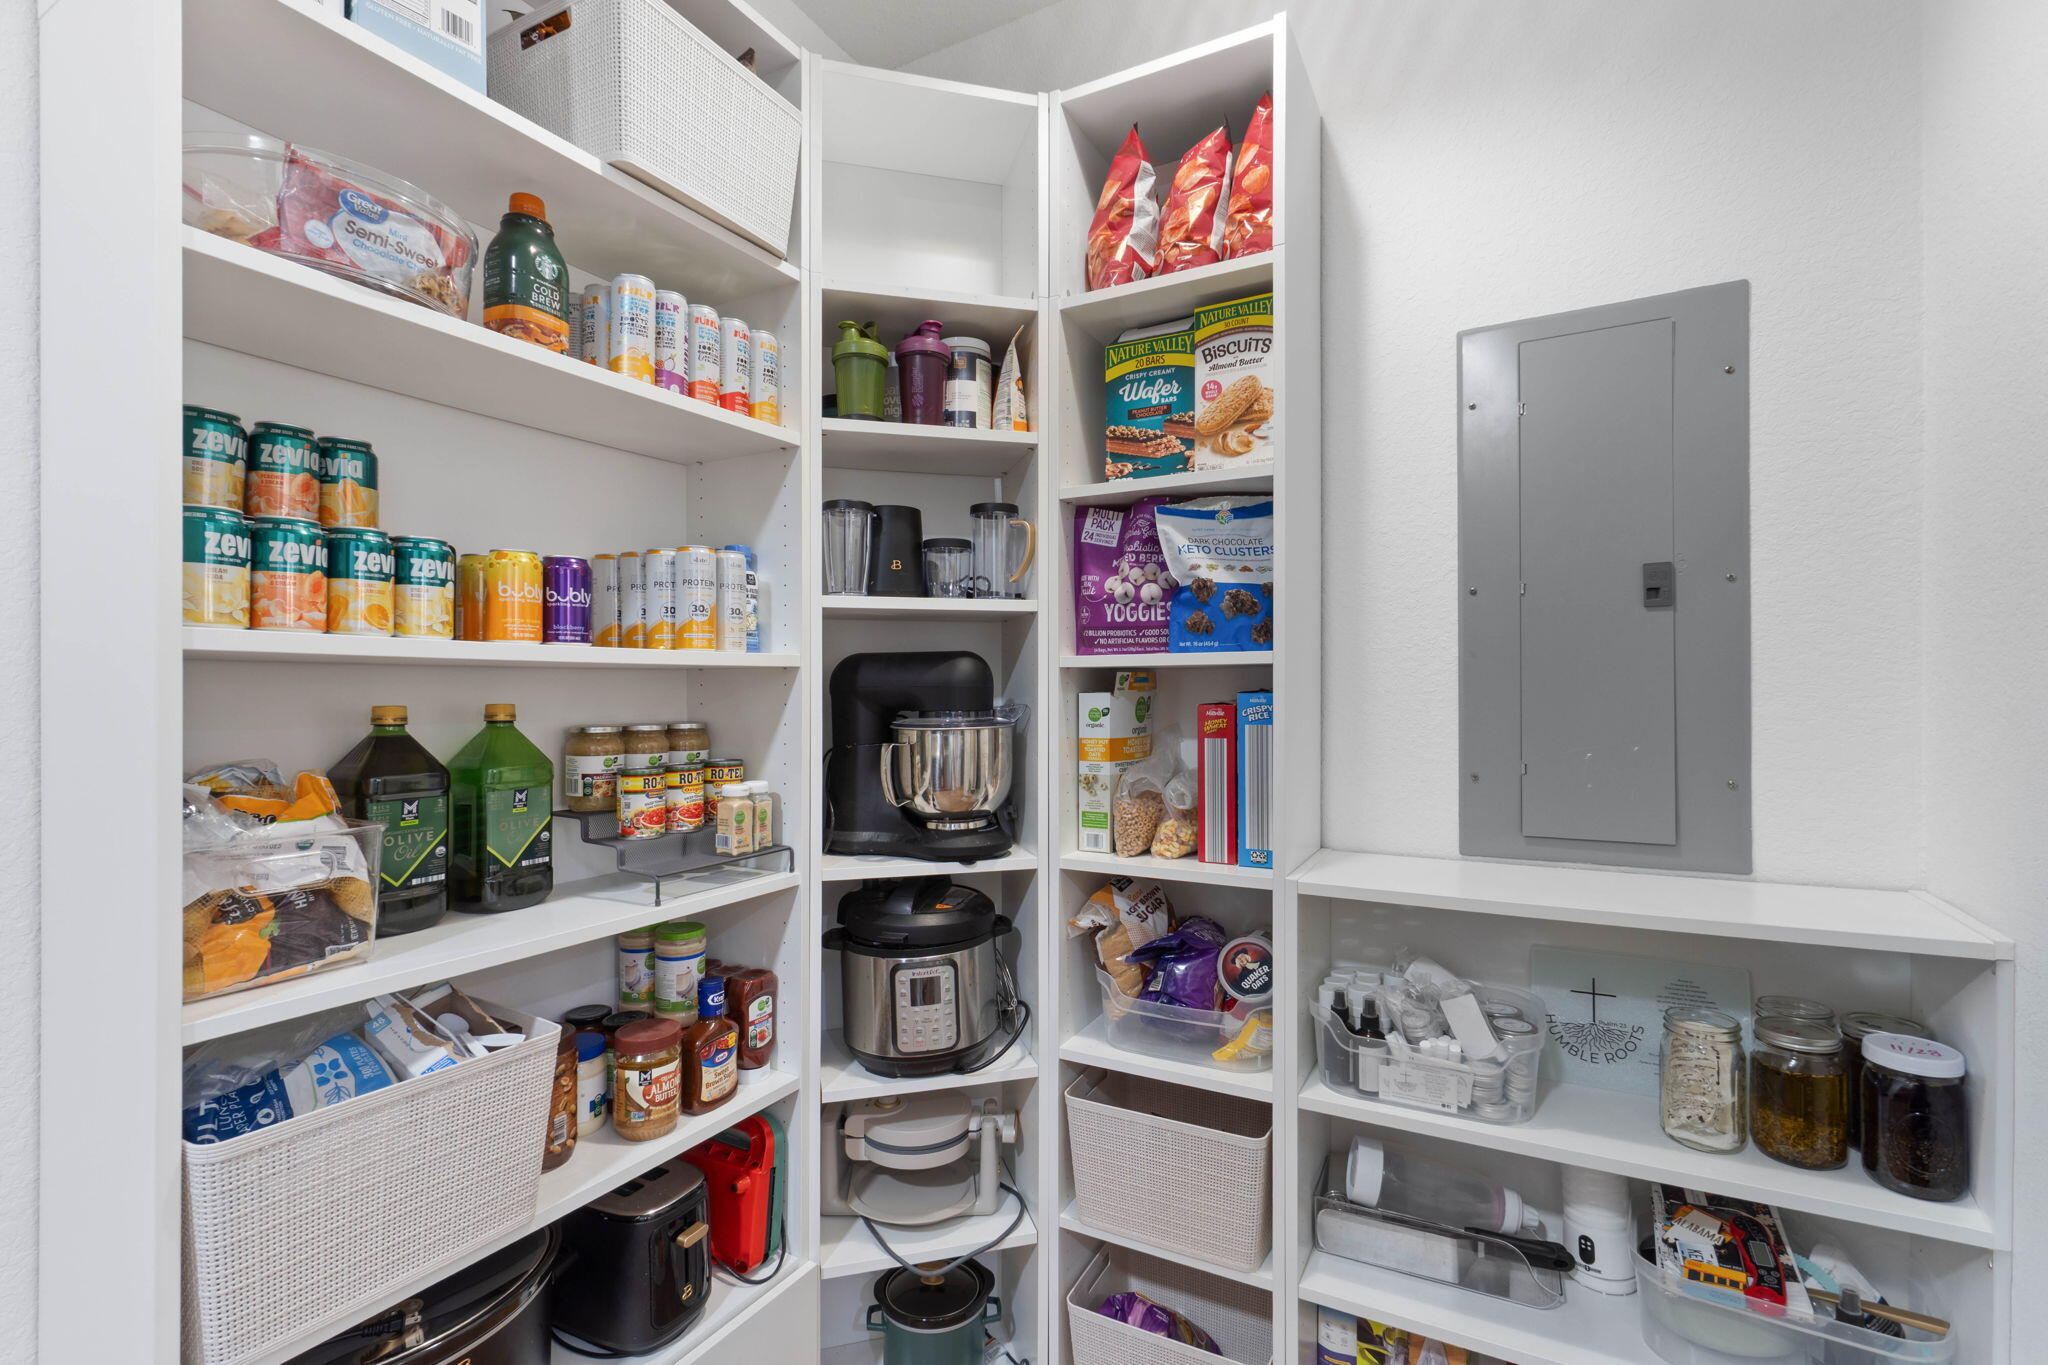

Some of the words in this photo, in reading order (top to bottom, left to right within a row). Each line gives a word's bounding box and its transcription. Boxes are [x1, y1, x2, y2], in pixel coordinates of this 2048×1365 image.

[347, 191, 383, 214] Great
[354, 203, 380, 220] Value
[345, 219, 439, 269] Semi-Sweet
[352, 238, 405, 265] Chocolate
[533, 283, 560, 301] COLD
[531, 291, 561, 311] BREW
[1200, 306, 1238, 329] NATURE
[1238, 298, 1273, 315] VALLEY
[1231, 317, 1249, 327] COUNT
[1109, 342, 1152, 367] NATURE
[1152, 334, 1194, 353] VALLEY
[1135, 358, 1145, 369] 20
[1145, 354, 1166, 366] BARS
[1208, 360, 1238, 372] Almond
[1239, 356, 1265, 367] Butter
[1125, 371, 1148, 381] CRISPY
[1148, 367, 1176, 377] CREAMY
[1119, 378, 1182, 405] Wafer
[1160, 395, 1178, 403] BARS
[318, 453, 363, 479] evia
[1090, 517, 1116, 532] PACK
[1083, 530, 1095, 541] 24
[1211, 538, 1264, 546] CHOCOLATE
[1177, 544, 1212, 555] KETO
[353, 550, 396, 575] zevi
[410, 556, 455, 582] zevi
[654, 581, 676, 589] PROT
[683, 579, 715, 587] PROTEIN
[546, 587, 592, 608] bubly
[1107, 629, 1137, 637] PROBIOTICS
[1144, 628, 1160, 636] GOOD
[1135, 636, 1158, 644] FLAVORS
[1242, 705, 1273, 717] CRISPY
[1248, 712, 1270, 722] RICE
[384, 830, 435, 847] OLIVE
[1241, 965, 1270, 989] QUAKER
[1251, 974, 1269, 990] OATS
[1545, 1014, 1599, 1064] HUMBLE
[1604, 1025, 1645, 1064] ROOTS
[646, 1074, 680, 1099] ALMON
[705, 1077, 723, 1089] Brown
[1673, 1217, 1724, 1246] ALABAMA
